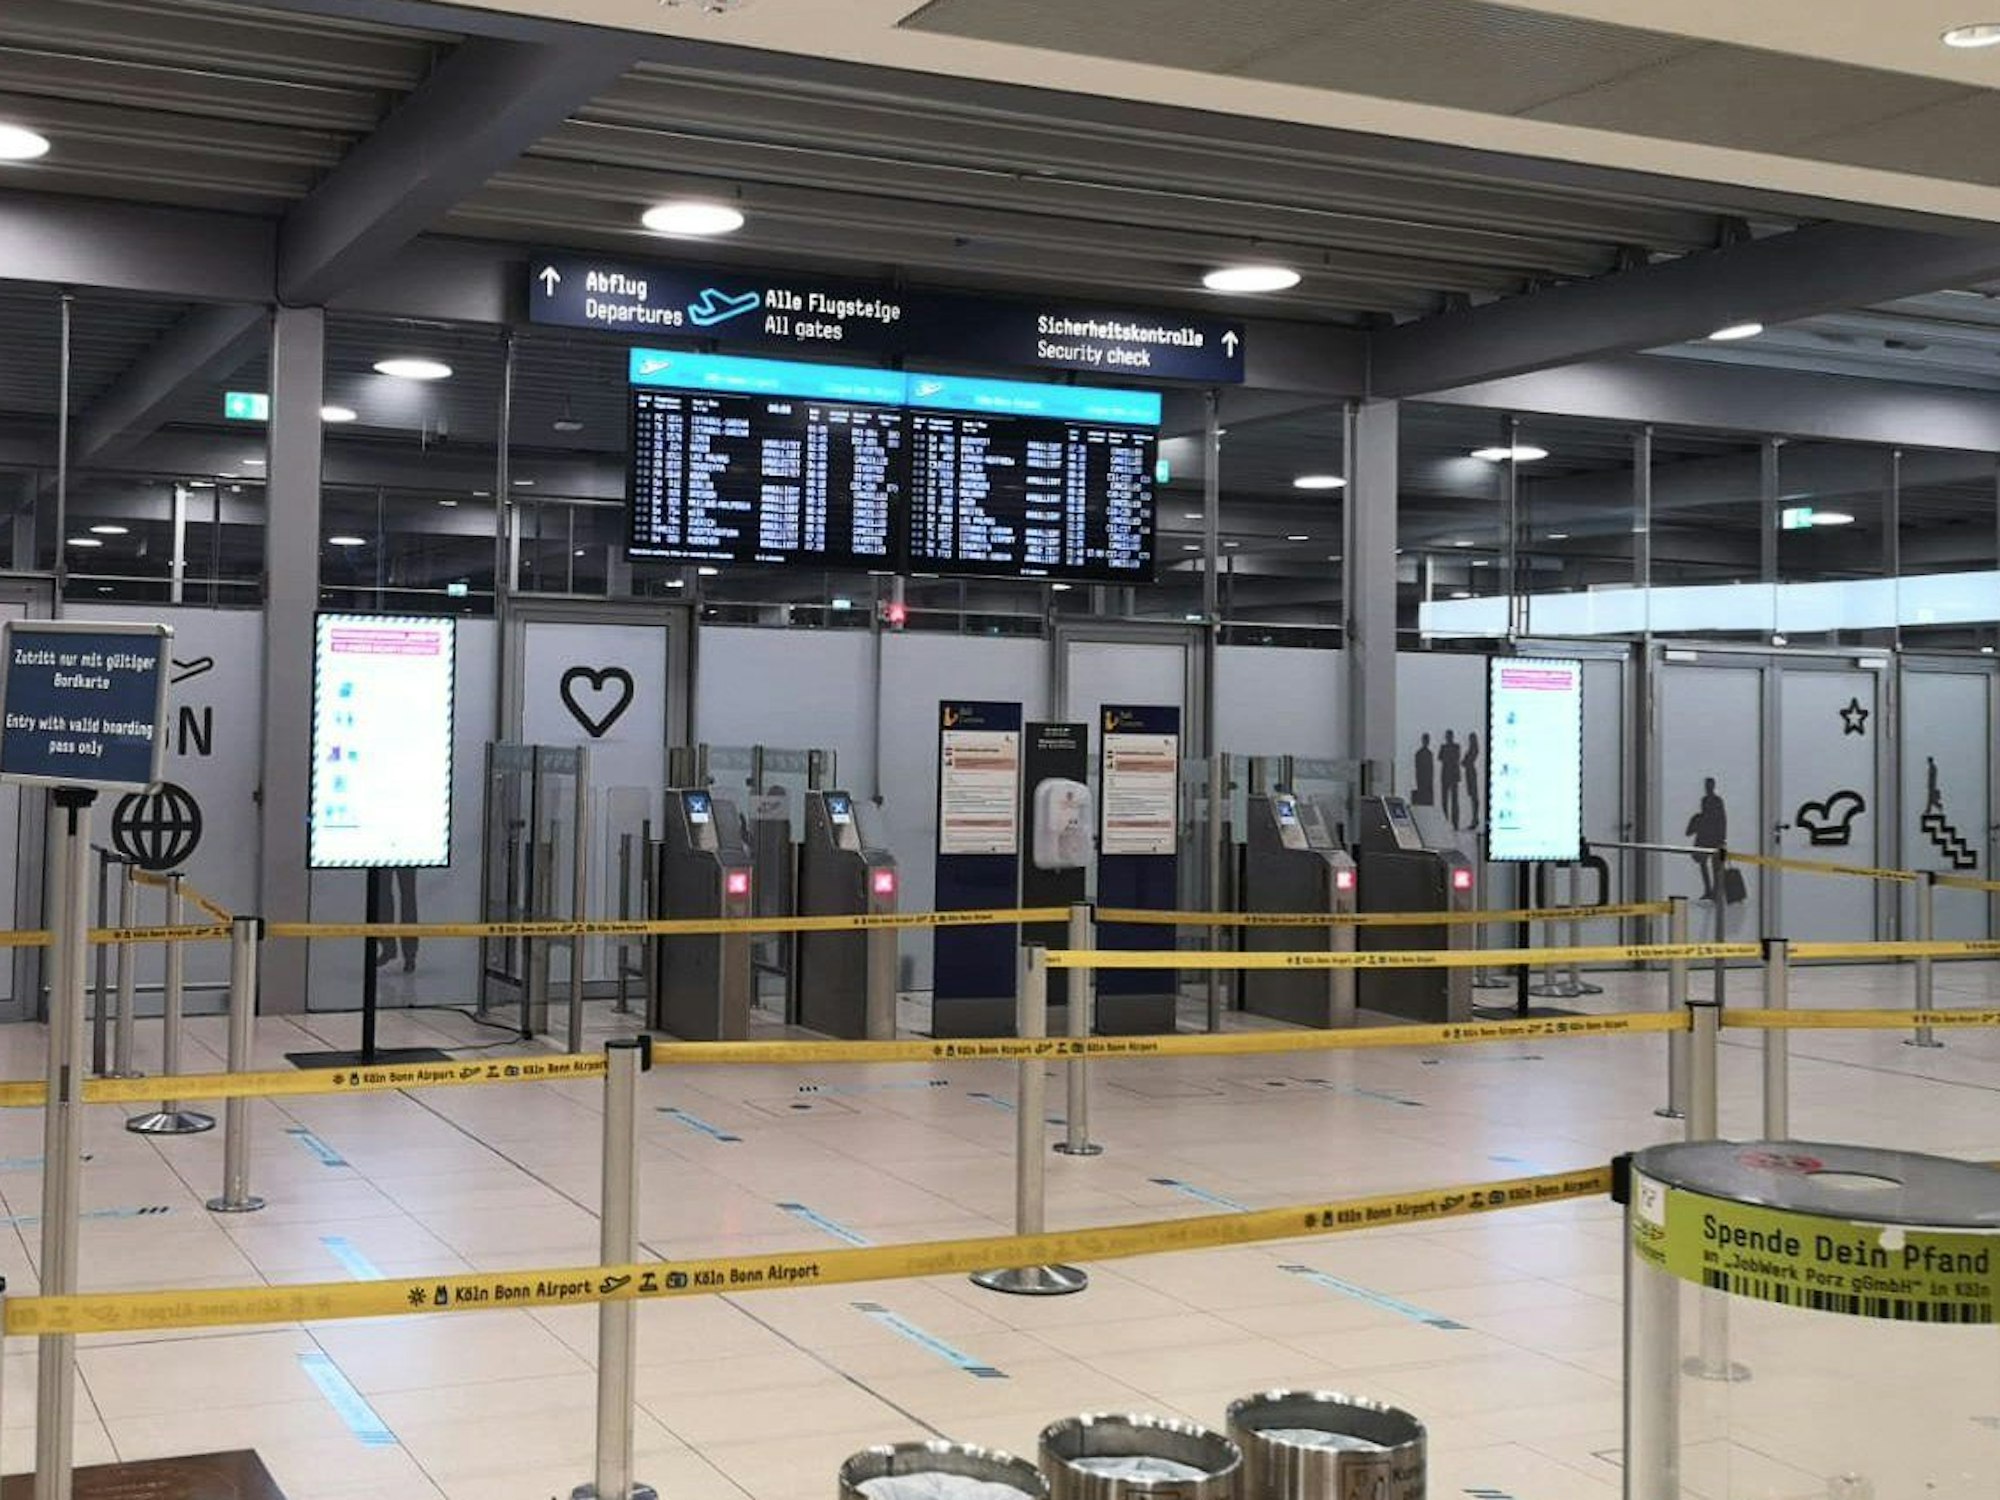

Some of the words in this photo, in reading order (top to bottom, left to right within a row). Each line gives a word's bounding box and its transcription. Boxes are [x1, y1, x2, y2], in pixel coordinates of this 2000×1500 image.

[586, 271, 647, 301] Abflug
[586, 298, 683, 326] Departures
[765, 290, 802, 311] Alle
[808, 293, 900, 323] Flugsteige
[765, 315, 789, 335] All
[795, 320, 843, 341] gates
[1038, 316, 1203, 347] Sicherheitskontrolle
[1038, 340, 1103, 365] Security
[1107, 347, 1150, 367] check
[15, 649, 56, 665] Zutritt
[59, 653, 78, 666] nur
[81, 652, 103, 667] mit
[106, 654, 156, 672] gültiger
[53, 672, 110, 690] Bordkarte
[6, 714, 35, 731] Entry
[38, 715, 66, 731] with
[69, 717, 100, 733] valid
[103, 719, 154, 741] boarding
[49, 740, 75, 755] pass
[78, 740, 104, 758] only
[1001, 1044, 1031, 1055] Airport
[1128, 1041, 1157, 1052] Airport
[363, 1072, 386, 1084] Köln
[390, 1071, 414, 1082] Bonn
[417, 1069, 454, 1083] Airport
[522, 1064, 545, 1076] Köln
[548, 1062, 570, 1074] Bonn
[574, 1059, 608, 1073] Airport
[1337, 1209, 1362, 1224] Köln
[1366, 1206, 1392, 1221] Bonn
[1396, 1201, 1437, 1217] Airport
[1508, 1187, 1532, 1200] Köln
[1535, 1185, 1559, 1198] Bonn
[1563, 1179, 1600, 1194] Airport
[1704, 1214, 1801, 1256] Spende
[1815, 1236, 1888, 1269] Dein
[1904, 1245, 1990, 1275] Pfand
[455, 1287, 488, 1302] Köln
[494, 1284, 530, 1300] Bonn
[536, 1281, 592, 1299] Airport
[694, 1271, 724, 1287] Köln
[730, 1268, 763, 1284] Bonn
[767, 1264, 819, 1282] Airport
[1806, 1268, 1843, 1287] Porz
[1930, 1282, 1948, 1296] in
[1955, 1283, 1992, 1298] Köln
